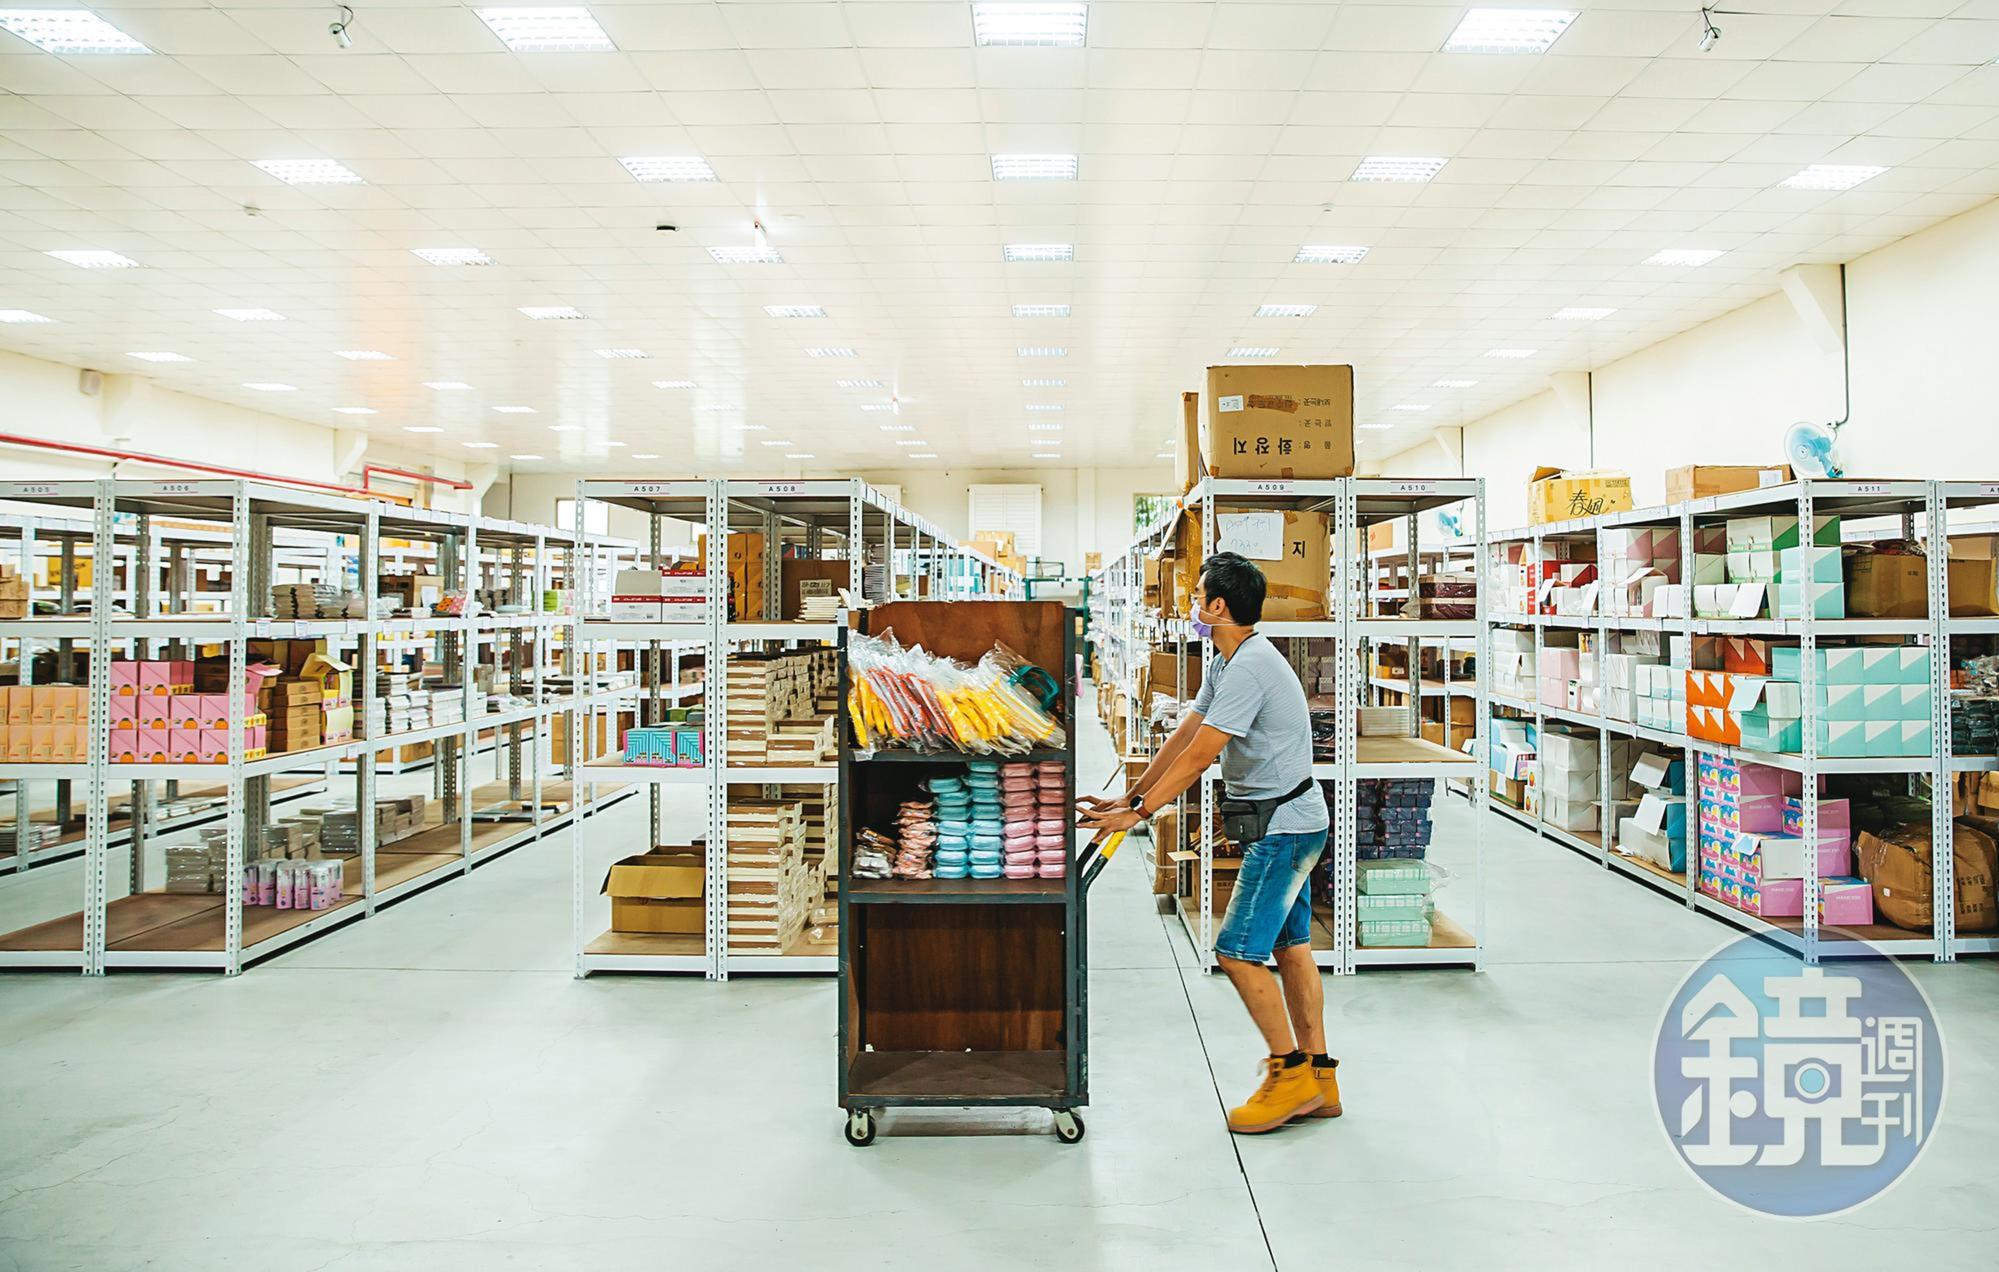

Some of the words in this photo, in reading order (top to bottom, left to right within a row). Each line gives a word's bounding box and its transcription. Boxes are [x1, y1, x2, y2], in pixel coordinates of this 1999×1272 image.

[162, 484, 190, 492] A506
[633, 485, 661, 493] A507
[768, 485, 796, 493] A508
[1257, 484, 1285, 492] A509
